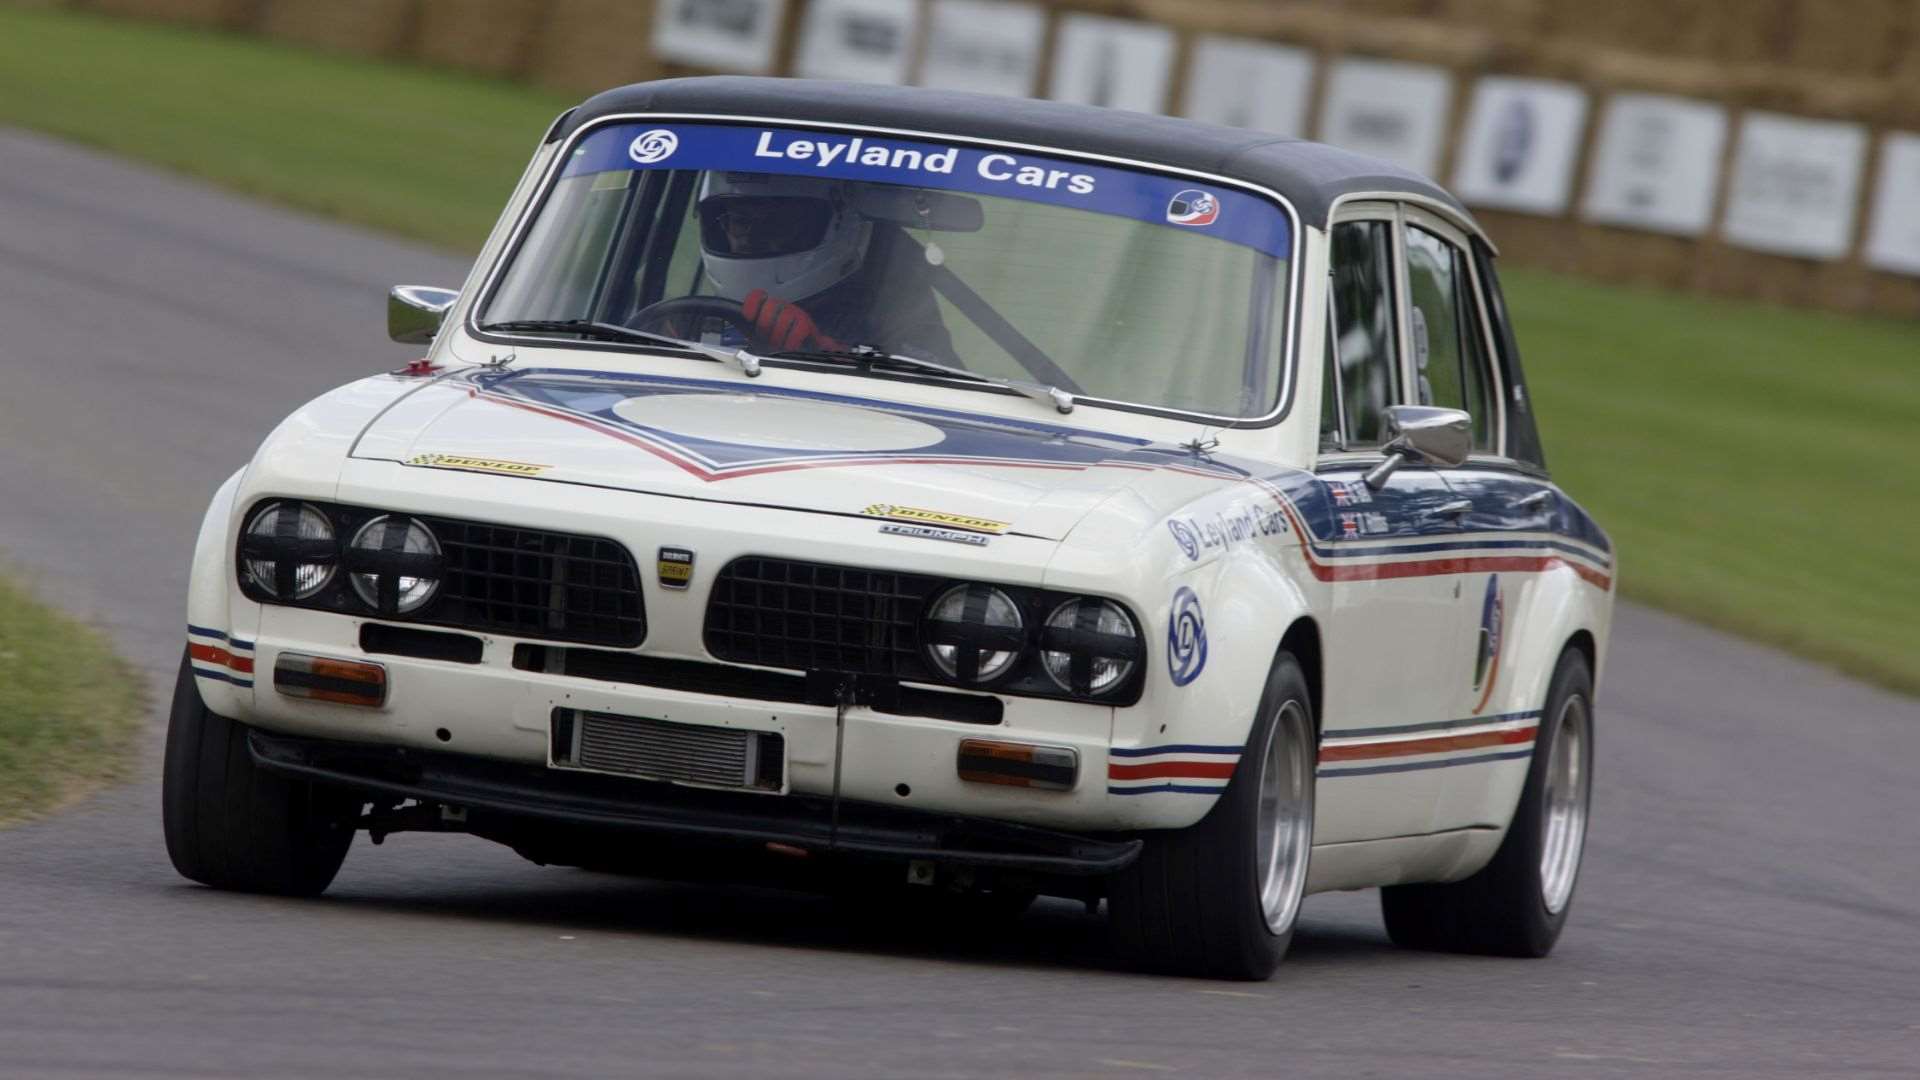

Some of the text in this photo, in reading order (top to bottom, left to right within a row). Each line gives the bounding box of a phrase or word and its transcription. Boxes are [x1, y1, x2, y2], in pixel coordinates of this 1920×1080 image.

[754, 131, 1096, 195] Leyland Cars
[444, 458, 540, 472] DUNLOP
[899, 508, 999, 528] DUNLOP
[1190, 504, 1288, 552] Leyland Cars
[881, 524, 988, 545] TRIUMPH
